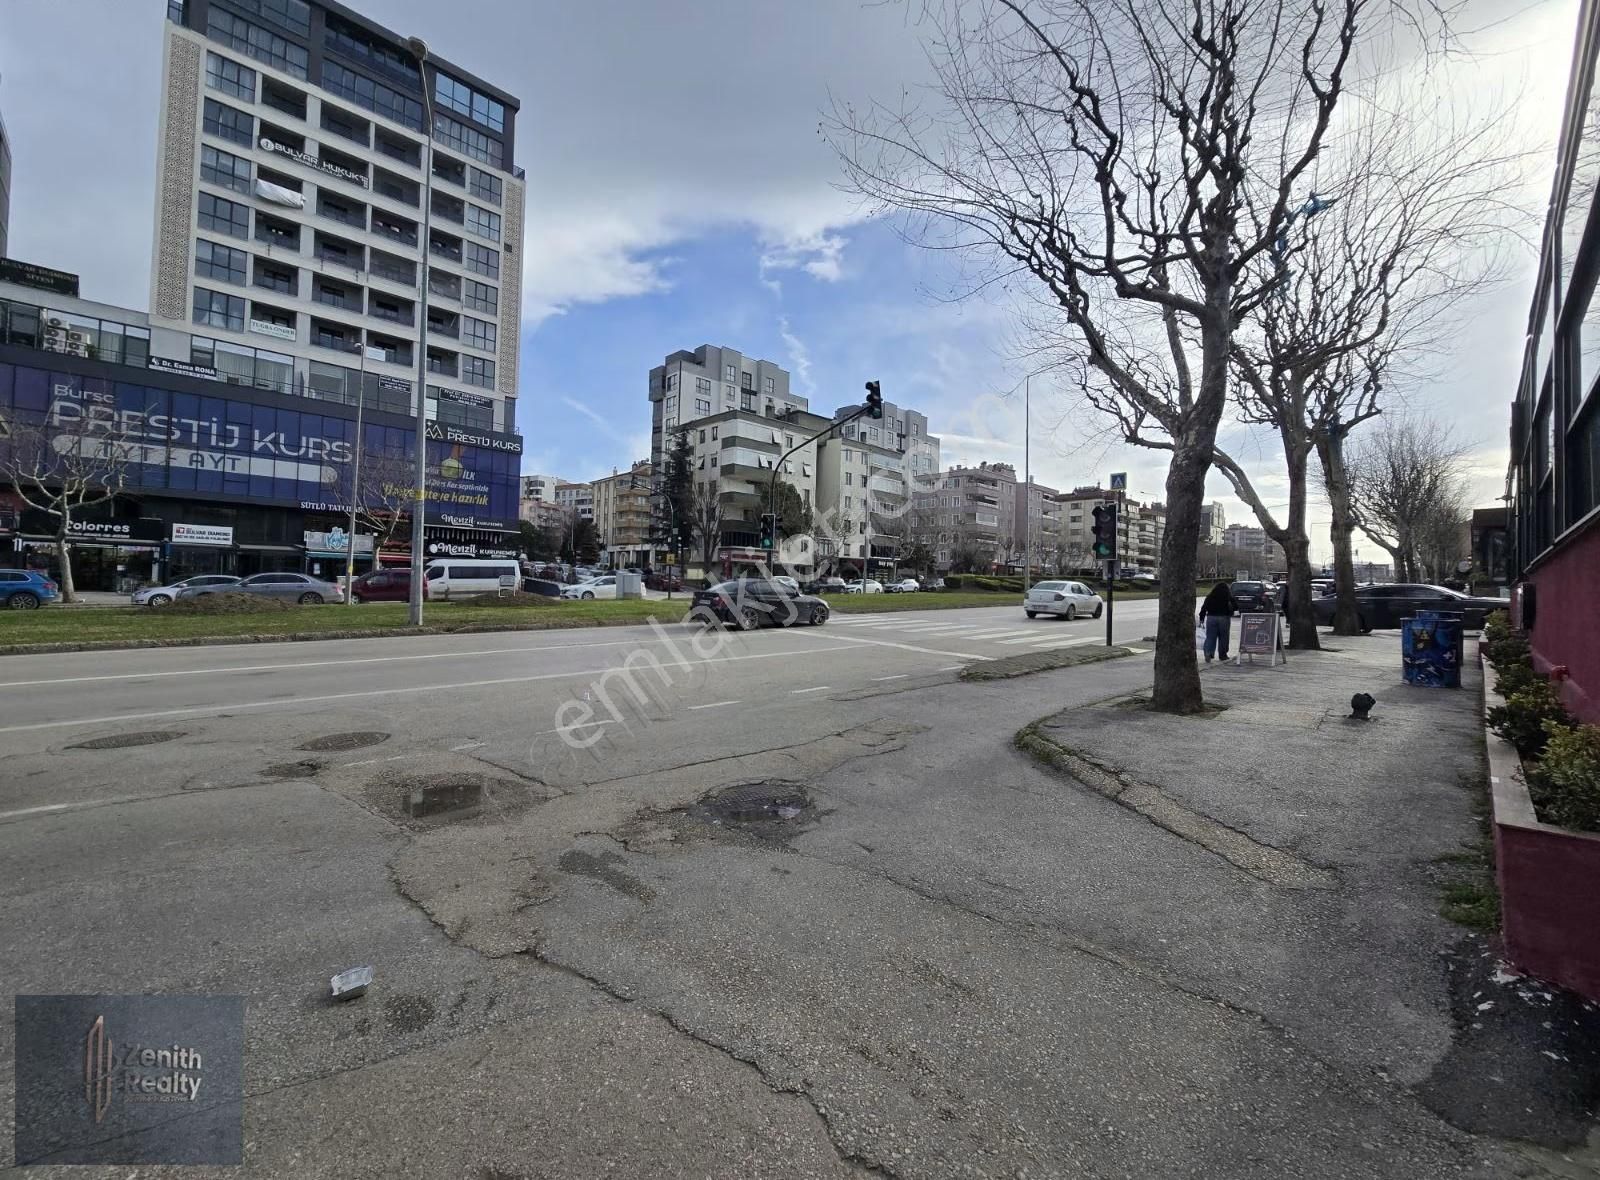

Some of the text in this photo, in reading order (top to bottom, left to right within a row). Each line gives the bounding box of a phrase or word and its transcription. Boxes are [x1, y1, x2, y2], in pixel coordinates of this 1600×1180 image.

[274, 143, 319, 165] BULVAR
[322, 161, 359, 179] HUKUK
[162, 360, 173, 368] Dr.
[253, 429, 352, 462] KURS
[492, 440, 521, 452] KURS
[99, 442, 156, 462] TYT
[189, 452, 241, 471] AYT
[441, 513, 474, 527] Menzil
[437, 542, 476, 558] Menzil
